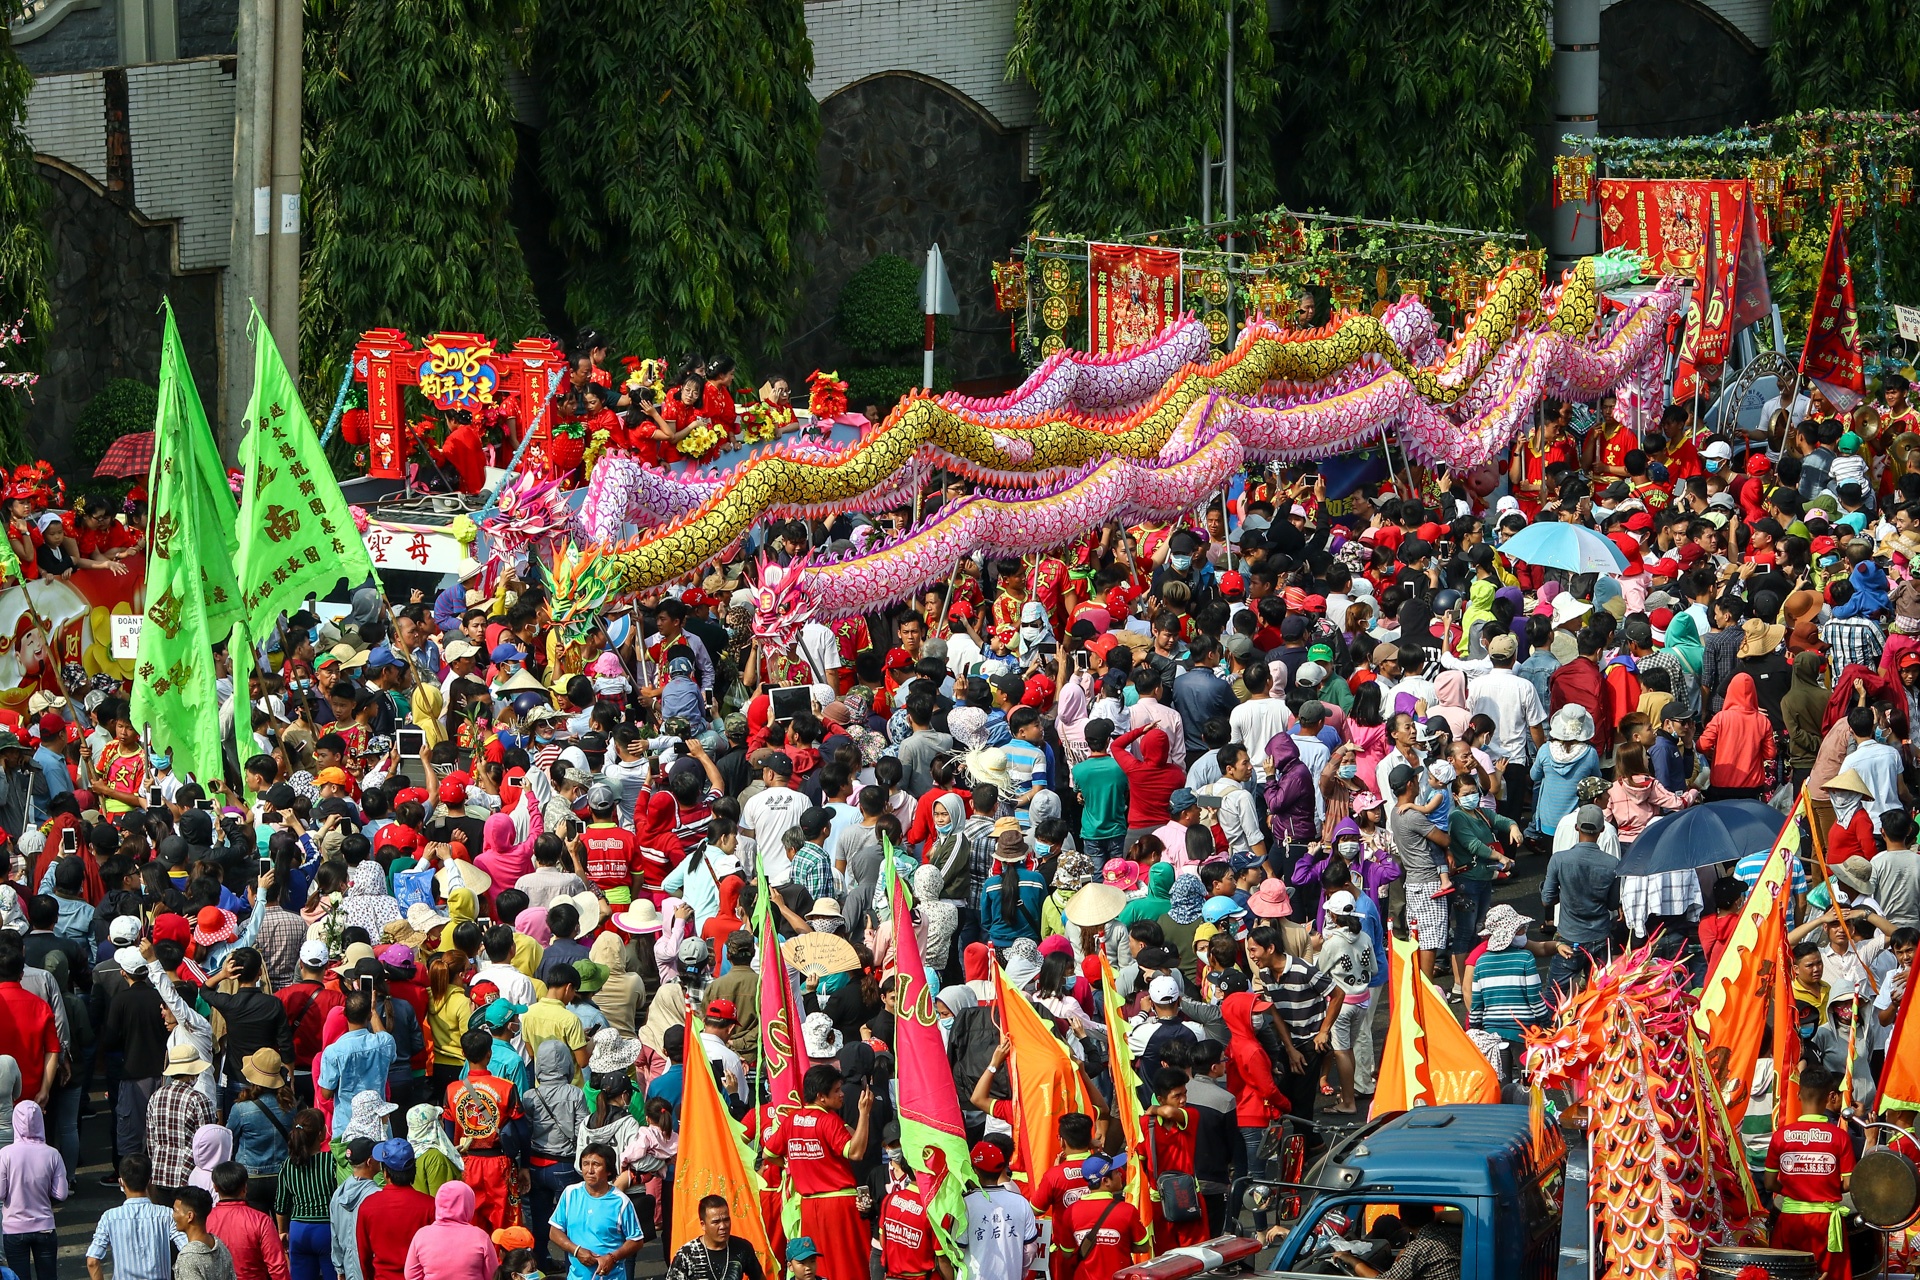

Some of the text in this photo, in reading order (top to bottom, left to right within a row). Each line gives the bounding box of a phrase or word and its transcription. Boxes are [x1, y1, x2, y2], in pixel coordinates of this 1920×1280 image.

[430, 343, 494, 377] 2018
[376, 367, 387, 421] 狗年大吉
[419, 373, 494, 404] 狗年大吉
[367, 529, 432, 566] 聖母
[117, 615, 138, 625] ĐOÀN
[1784, 1128, 1833, 1146] Long Kun
